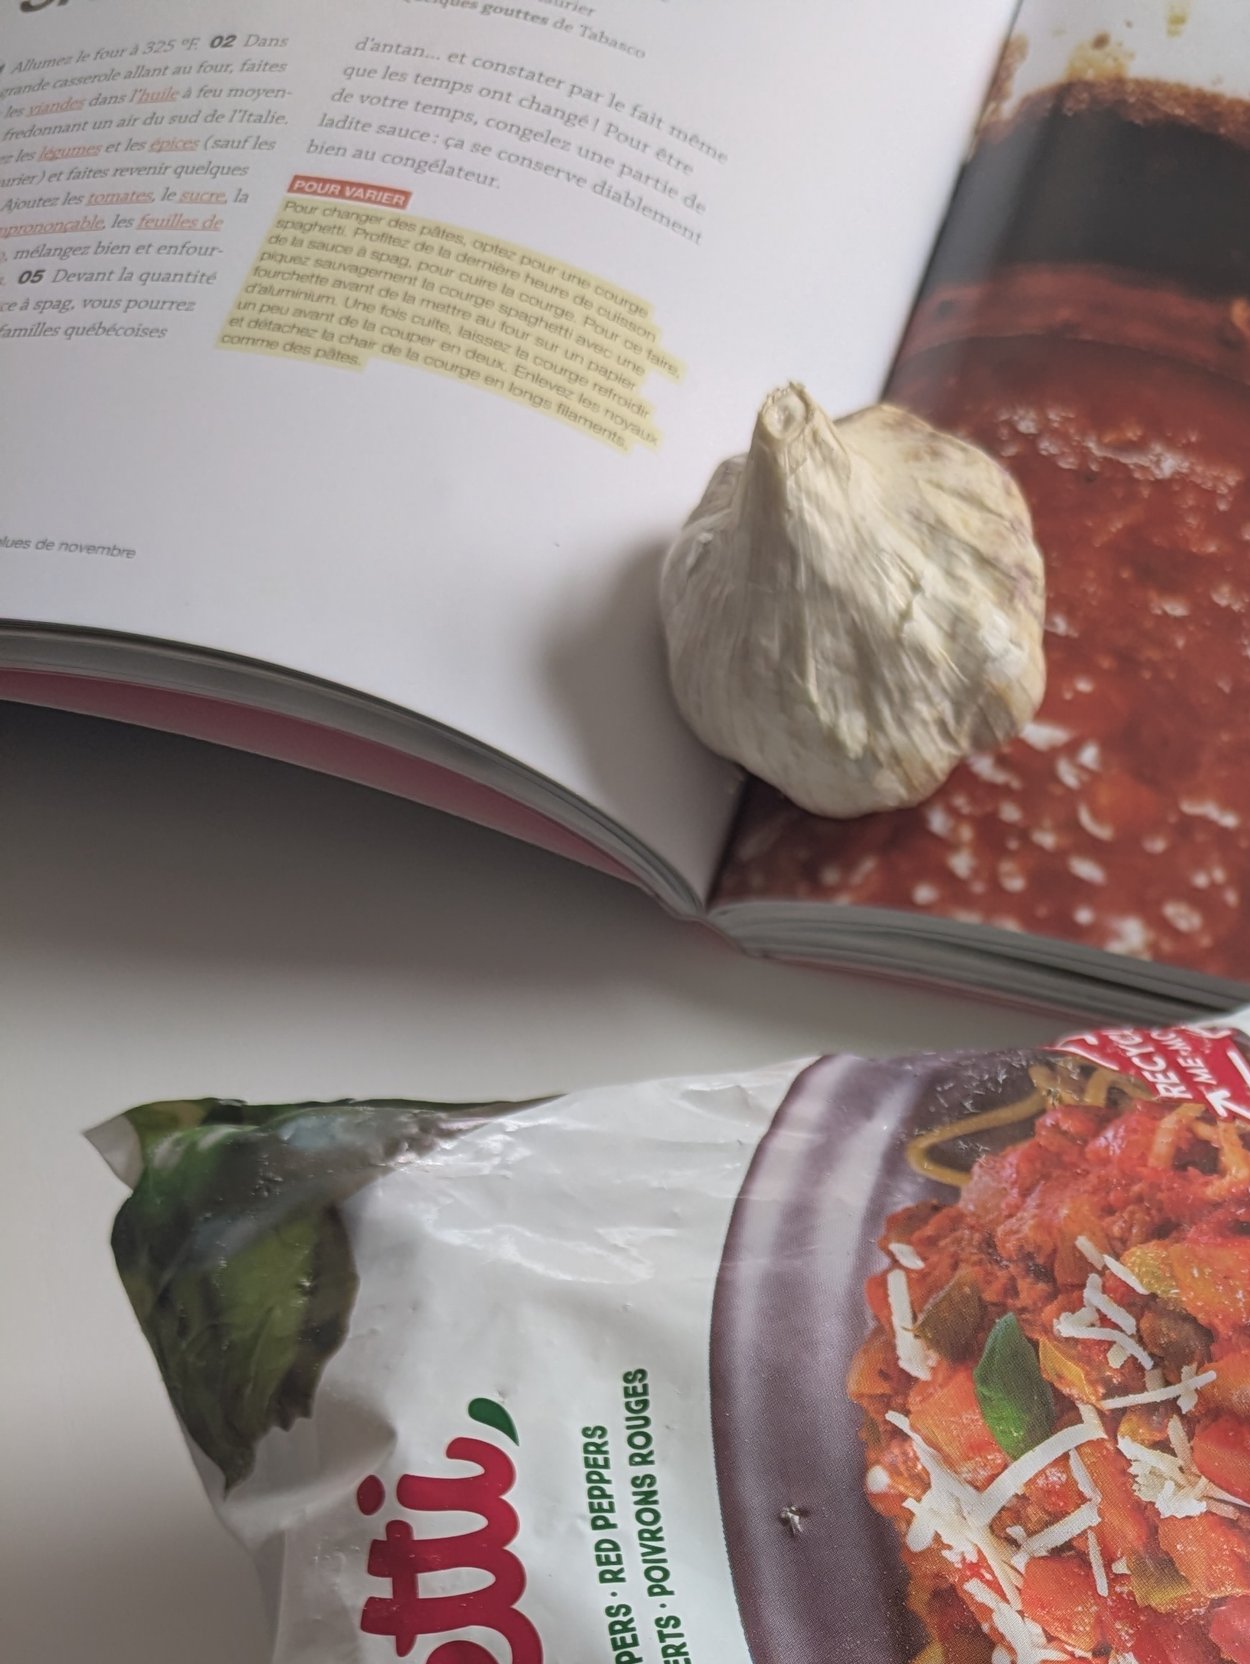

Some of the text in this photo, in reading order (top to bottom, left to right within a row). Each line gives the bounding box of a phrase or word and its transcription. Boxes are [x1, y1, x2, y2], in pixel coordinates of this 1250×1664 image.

[11, 53, 72, 74] Allumez
[93, 47, 125, 61] four
[142, 39, 176, 54] 325
[209, 35, 237, 49] 02
[243, 35, 288, 48] Dans
[480, 4, 646, 59] gouttes de Tabasco
[52, 59, 288, 89] casserole allant faites
[3, 110, 200, 142] fredonnant sud
[29, 91, 125, 116] viandes dans
[343, 65, 694, 175] que les temps ont changé Pour être
[472, 57, 729, 164] constater par fait même
[66, 162, 250, 181] faites revenir quelques
[306, 139, 347, 158] bien
[352, 148, 376, 162] au
[331, 88, 706, 216] de votre temps, congelez une partie de
[293, 180, 406, 206] POUR VARIER
[318, 113, 704, 246] ladite conserve diablement
[13, 242, 132, 260] mélangez bien
[18, 269, 216, 287] 05 Devant quantité
[284, 200, 319, 215] Pour
[322, 205, 385, 226] changer
[387, 218, 417, 232] des
[519, 253, 559, 276] pour
[561, 270, 592, 290] une
[594, 285, 649, 320] courge
[83, 299, 196, 314] vous pourrez
[313, 259, 574, 341] sauvagement courge spaghetti
[353, 227, 411, 248] Profitez
[524, 272, 570, 300] heure
[596, 305, 657, 344] cuisson
[0, 323, 168, 340] familles québécoises
[253, 266, 637, 391] fourchette avant mettre papier
[423, 355, 480, 381] courge
[508, 381, 552, 411] longs
[457, 325, 651, 419] laissez courge refroidir
[35, 538, 137, 559] de novembre
[623, 1367, 655, 1467] ROUGES
[581, 1424, 618, 1531] PEPPERS
[595, 1538, 627, 1584] RED
[630, 1473, 675, 1598] POIVRONS
